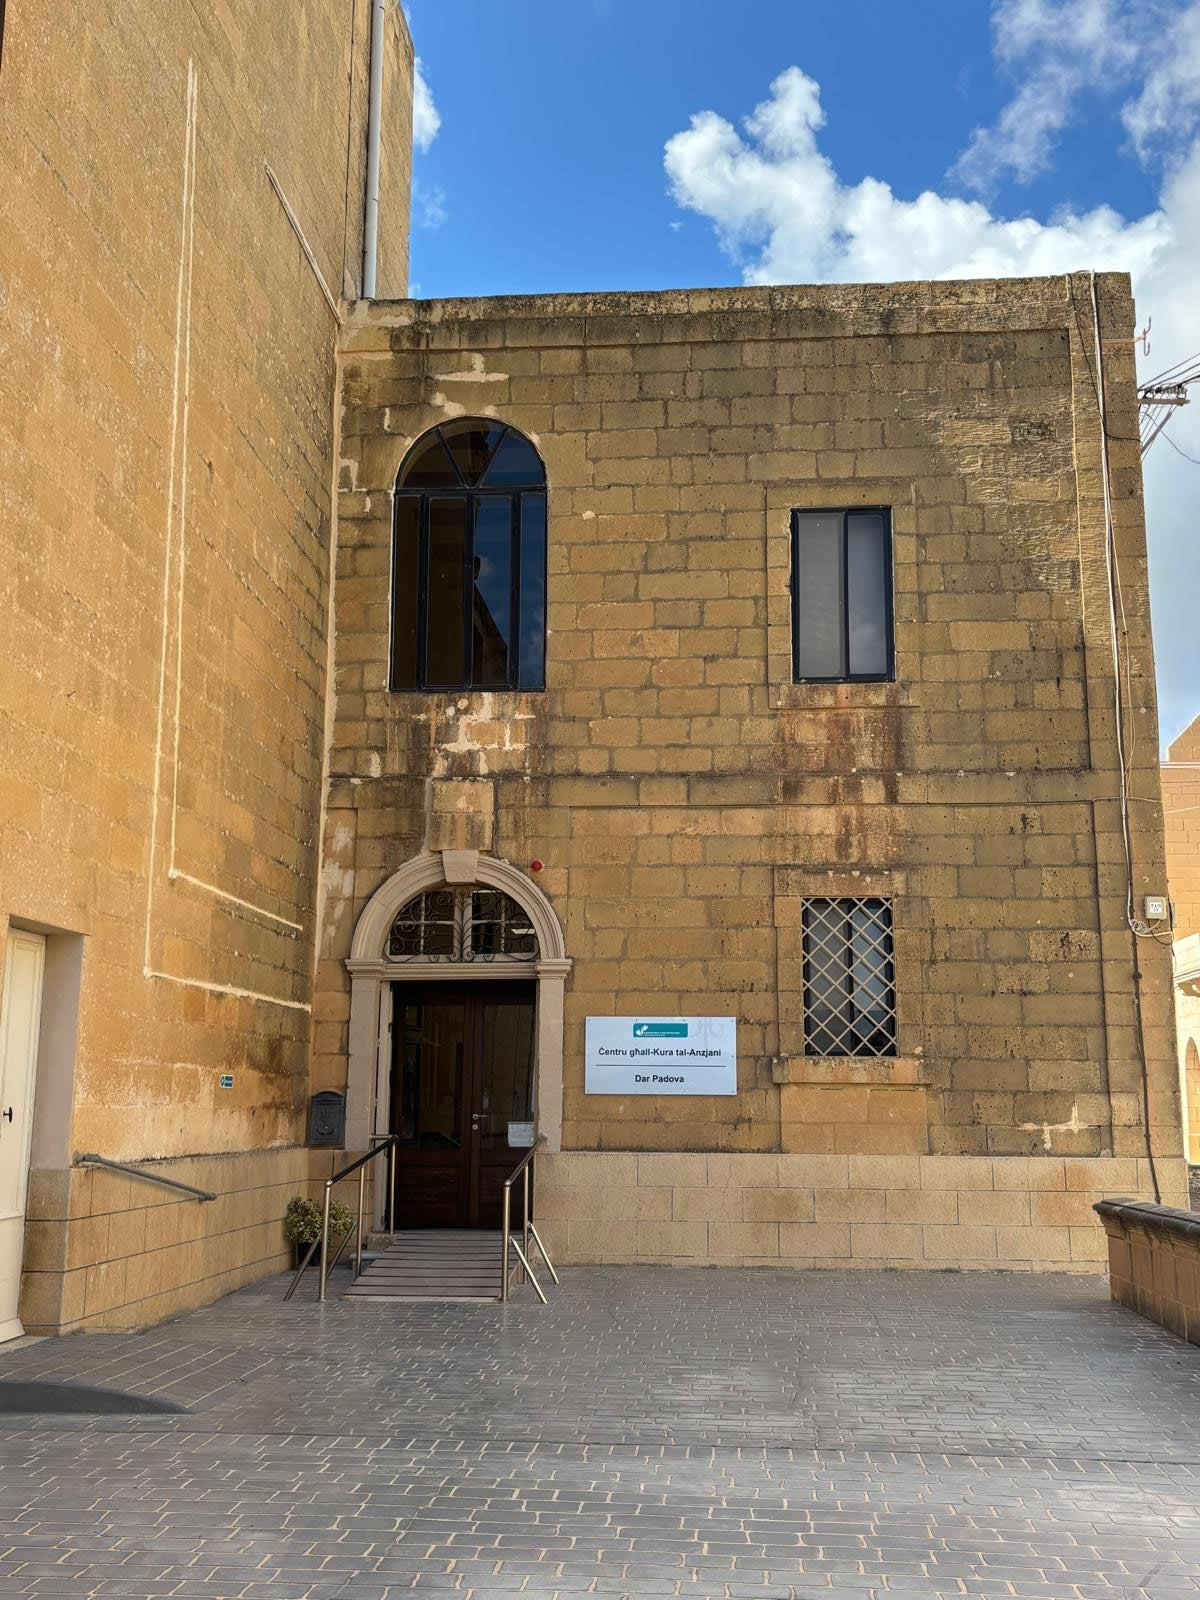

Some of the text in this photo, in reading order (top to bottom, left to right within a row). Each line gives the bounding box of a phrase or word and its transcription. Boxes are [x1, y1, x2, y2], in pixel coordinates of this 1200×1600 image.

[676, 1048, 721, 1058] tal-Anzjani
[635, 1074, 685, 1083] Dar Padova
